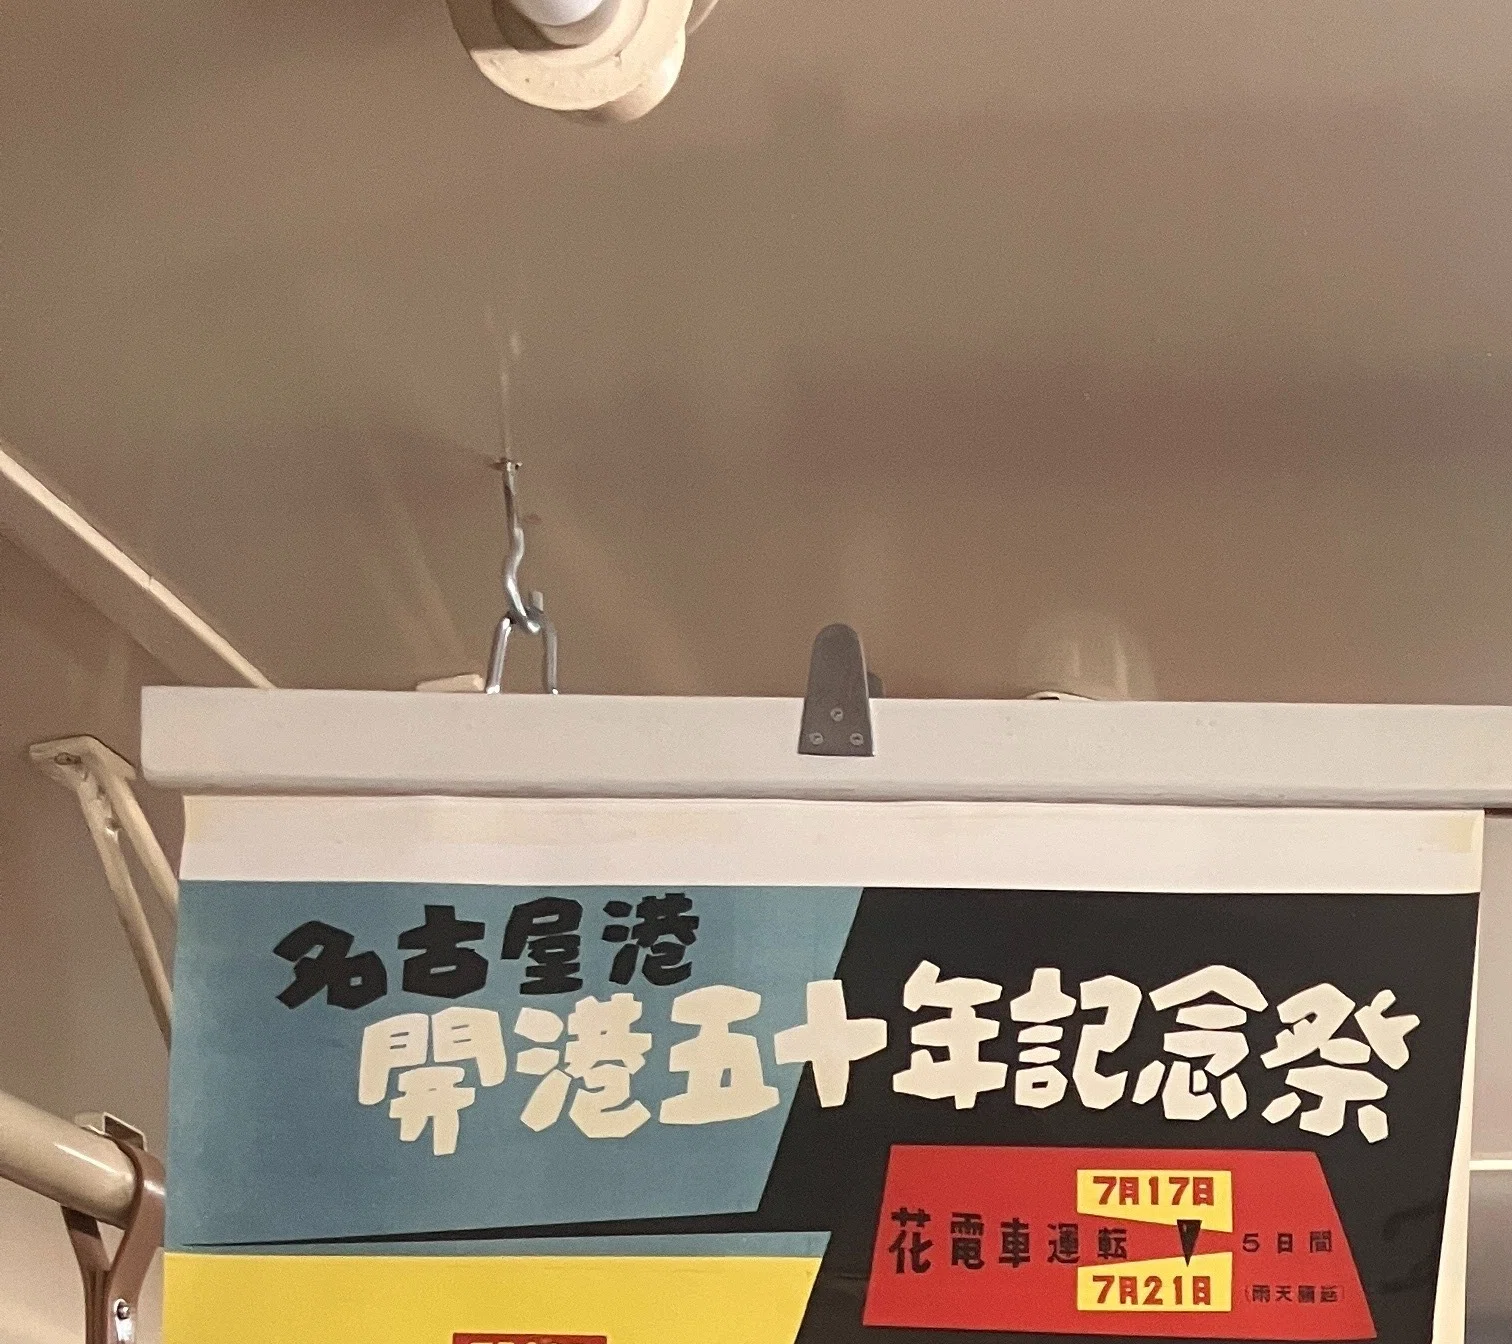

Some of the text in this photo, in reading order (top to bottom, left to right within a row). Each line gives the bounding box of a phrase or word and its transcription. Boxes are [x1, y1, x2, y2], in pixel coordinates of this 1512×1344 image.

[273, 893, 699, 1009] 名古屋港
[358, 960, 1420, 1156] 開港五十年記念祭
[1092, 1176, 1214, 1206] 7月17日
[889, 1208, 1129, 1274] 花電車運転
[1242, 1230, 1333, 1253] 5日間
[1092, 1275, 1212, 1306] 7月21日
